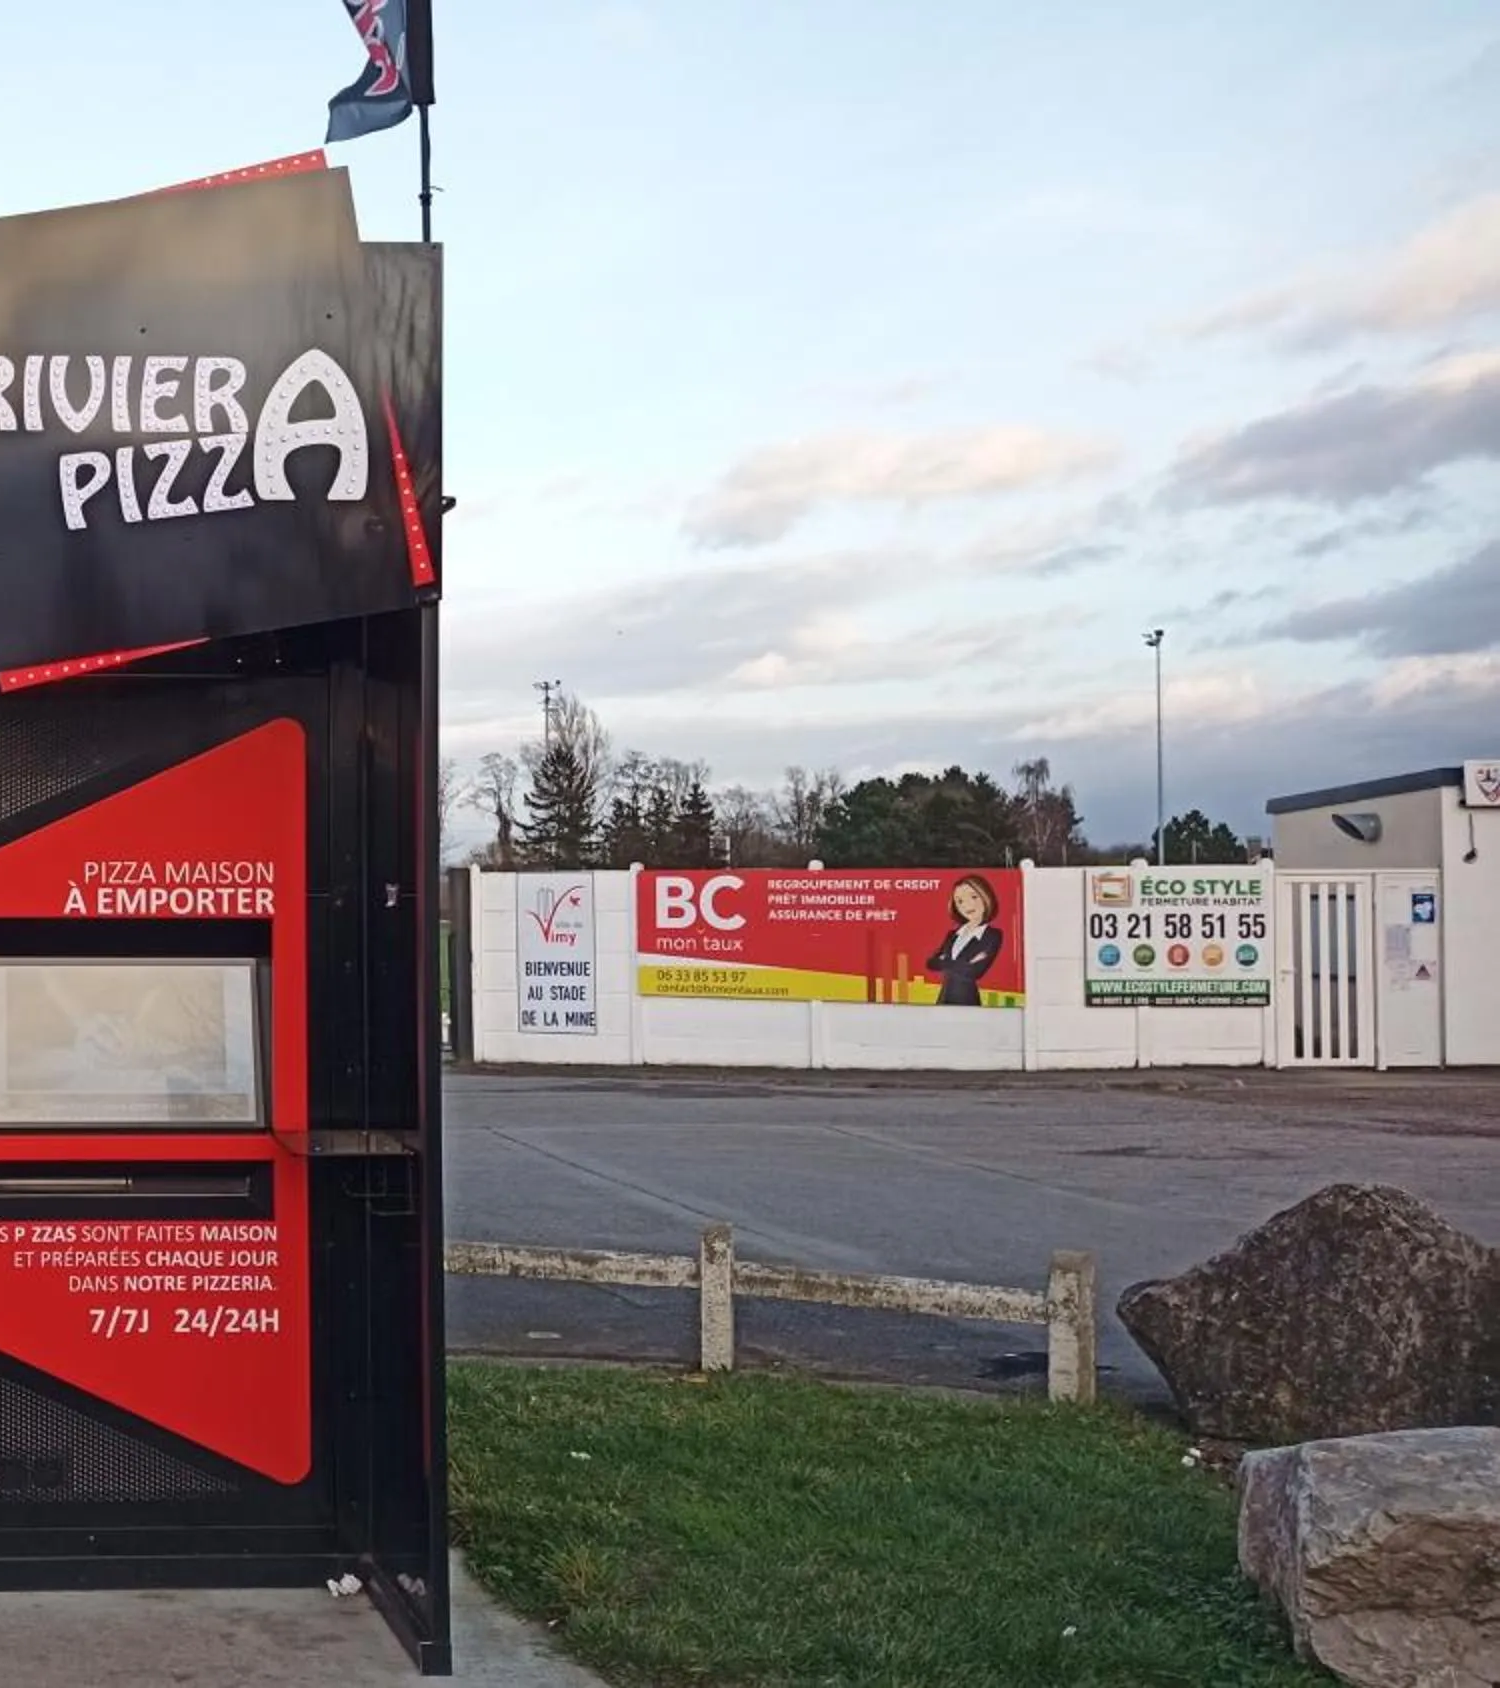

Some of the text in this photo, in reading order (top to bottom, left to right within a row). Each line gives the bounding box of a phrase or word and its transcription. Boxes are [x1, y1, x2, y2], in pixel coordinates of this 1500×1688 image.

[84, 862, 274, 884] PIZZA MAISON
[1140, 876, 1262, 895] ÉCO STYLE
[63, 881, 275, 914] À EMPORTER
[655, 875, 747, 931] BC
[873, 880, 892, 890] DE
[801, 895, 875, 905] IMMOBILIER
[1140, 898, 1263, 906] FERMETURE HABITAT
[769, 909, 842, 920] ASSURANCE
[845, 910, 863, 921] DE
[1090, 913, 1266, 939] 03 21 58 51 55
[657, 936, 743, 951] mon taux
[525, 961, 591, 977] BIENVENUE
[674, 970, 690, 982] 33
[731, 972, 747, 983] 97
[527, 986, 586, 1001] AU STADE
[522, 1011, 596, 1028] DE LA MINE
[81, 1226, 131, 1242] SONT
[137, 1226, 195, 1242] FAITES
[200, 1225, 277, 1242] MAISON
[14, 1247, 278, 1271] ET PRÉPARÉES CHAQUE JOUR
[69, 1277, 119, 1293] DANS
[124, 1276, 187, 1291] NOTRE
[89, 1306, 279, 1338] 7/7J 24/24H
